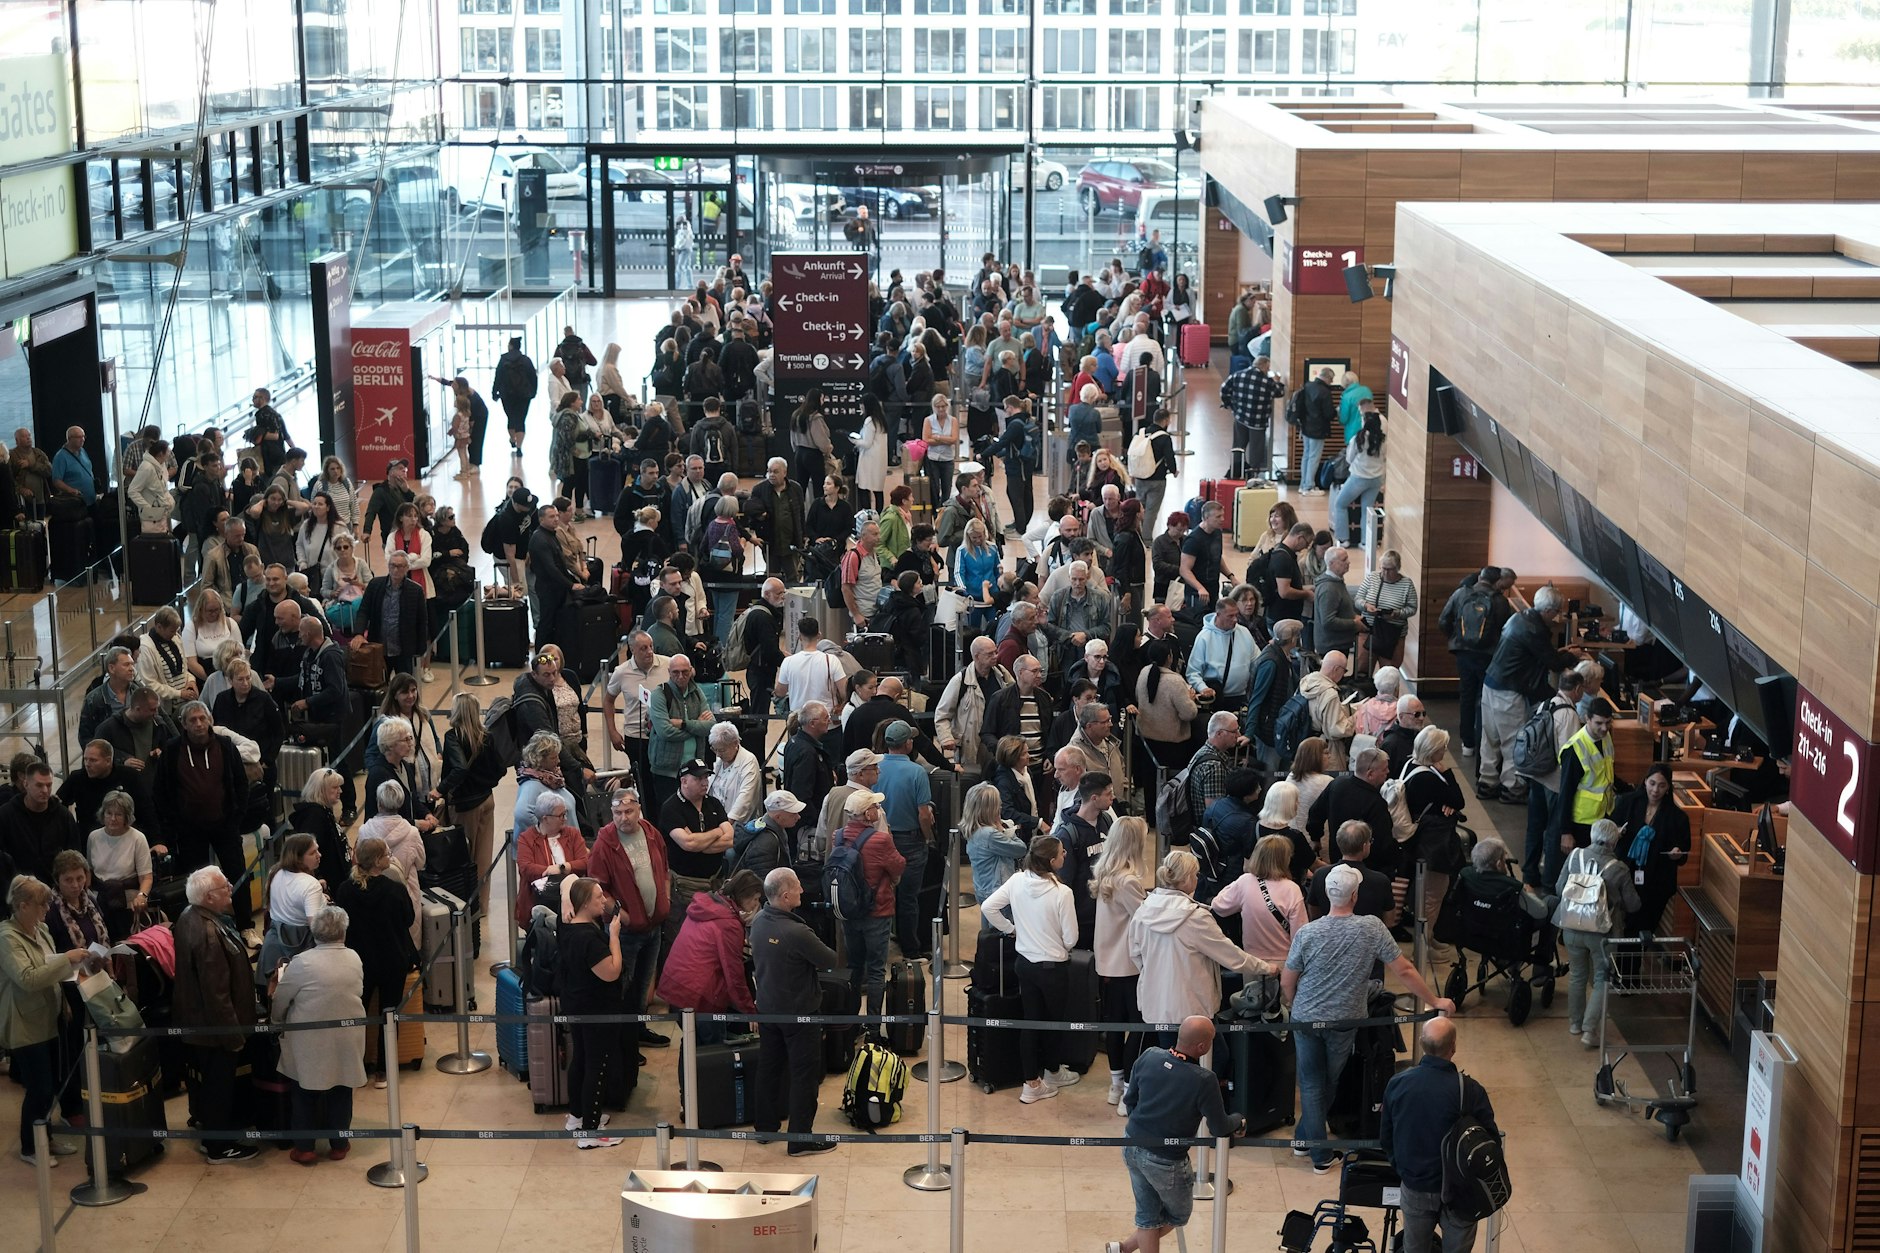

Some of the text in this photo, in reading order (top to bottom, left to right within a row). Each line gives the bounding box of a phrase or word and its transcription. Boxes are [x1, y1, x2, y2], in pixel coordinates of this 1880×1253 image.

[1378, 32, 1408, 48] FAY
[58, 184, 66, 216] 0
[1302, 250, 1333, 259] Check-in
[803, 261, 845, 270] Ankunft
[820, 272, 845, 280] Arrival
[795, 292, 839, 302] Check-in
[795, 303, 803, 313] 0
[802, 321, 846, 331] Check-in
[351, 340, 402, 358] Coca-Cola
[816, 357, 827, 366] T2
[353, 365, 403, 374] GOODBYE
[1401, 350, 1409, 397] 2
[353, 375, 404, 386] BERLIN
[374, 436, 387, 445] Fly
[361, 442, 400, 451] refreshed!
[1673, 578, 1684, 601] 215
[1708, 609, 1721, 634] 216
[1800, 700, 1833, 748] Check-in
[1836, 740, 1860, 837] 2
[825, 1134, 840, 1142] BER
[753, 1225, 777, 1236] BER
